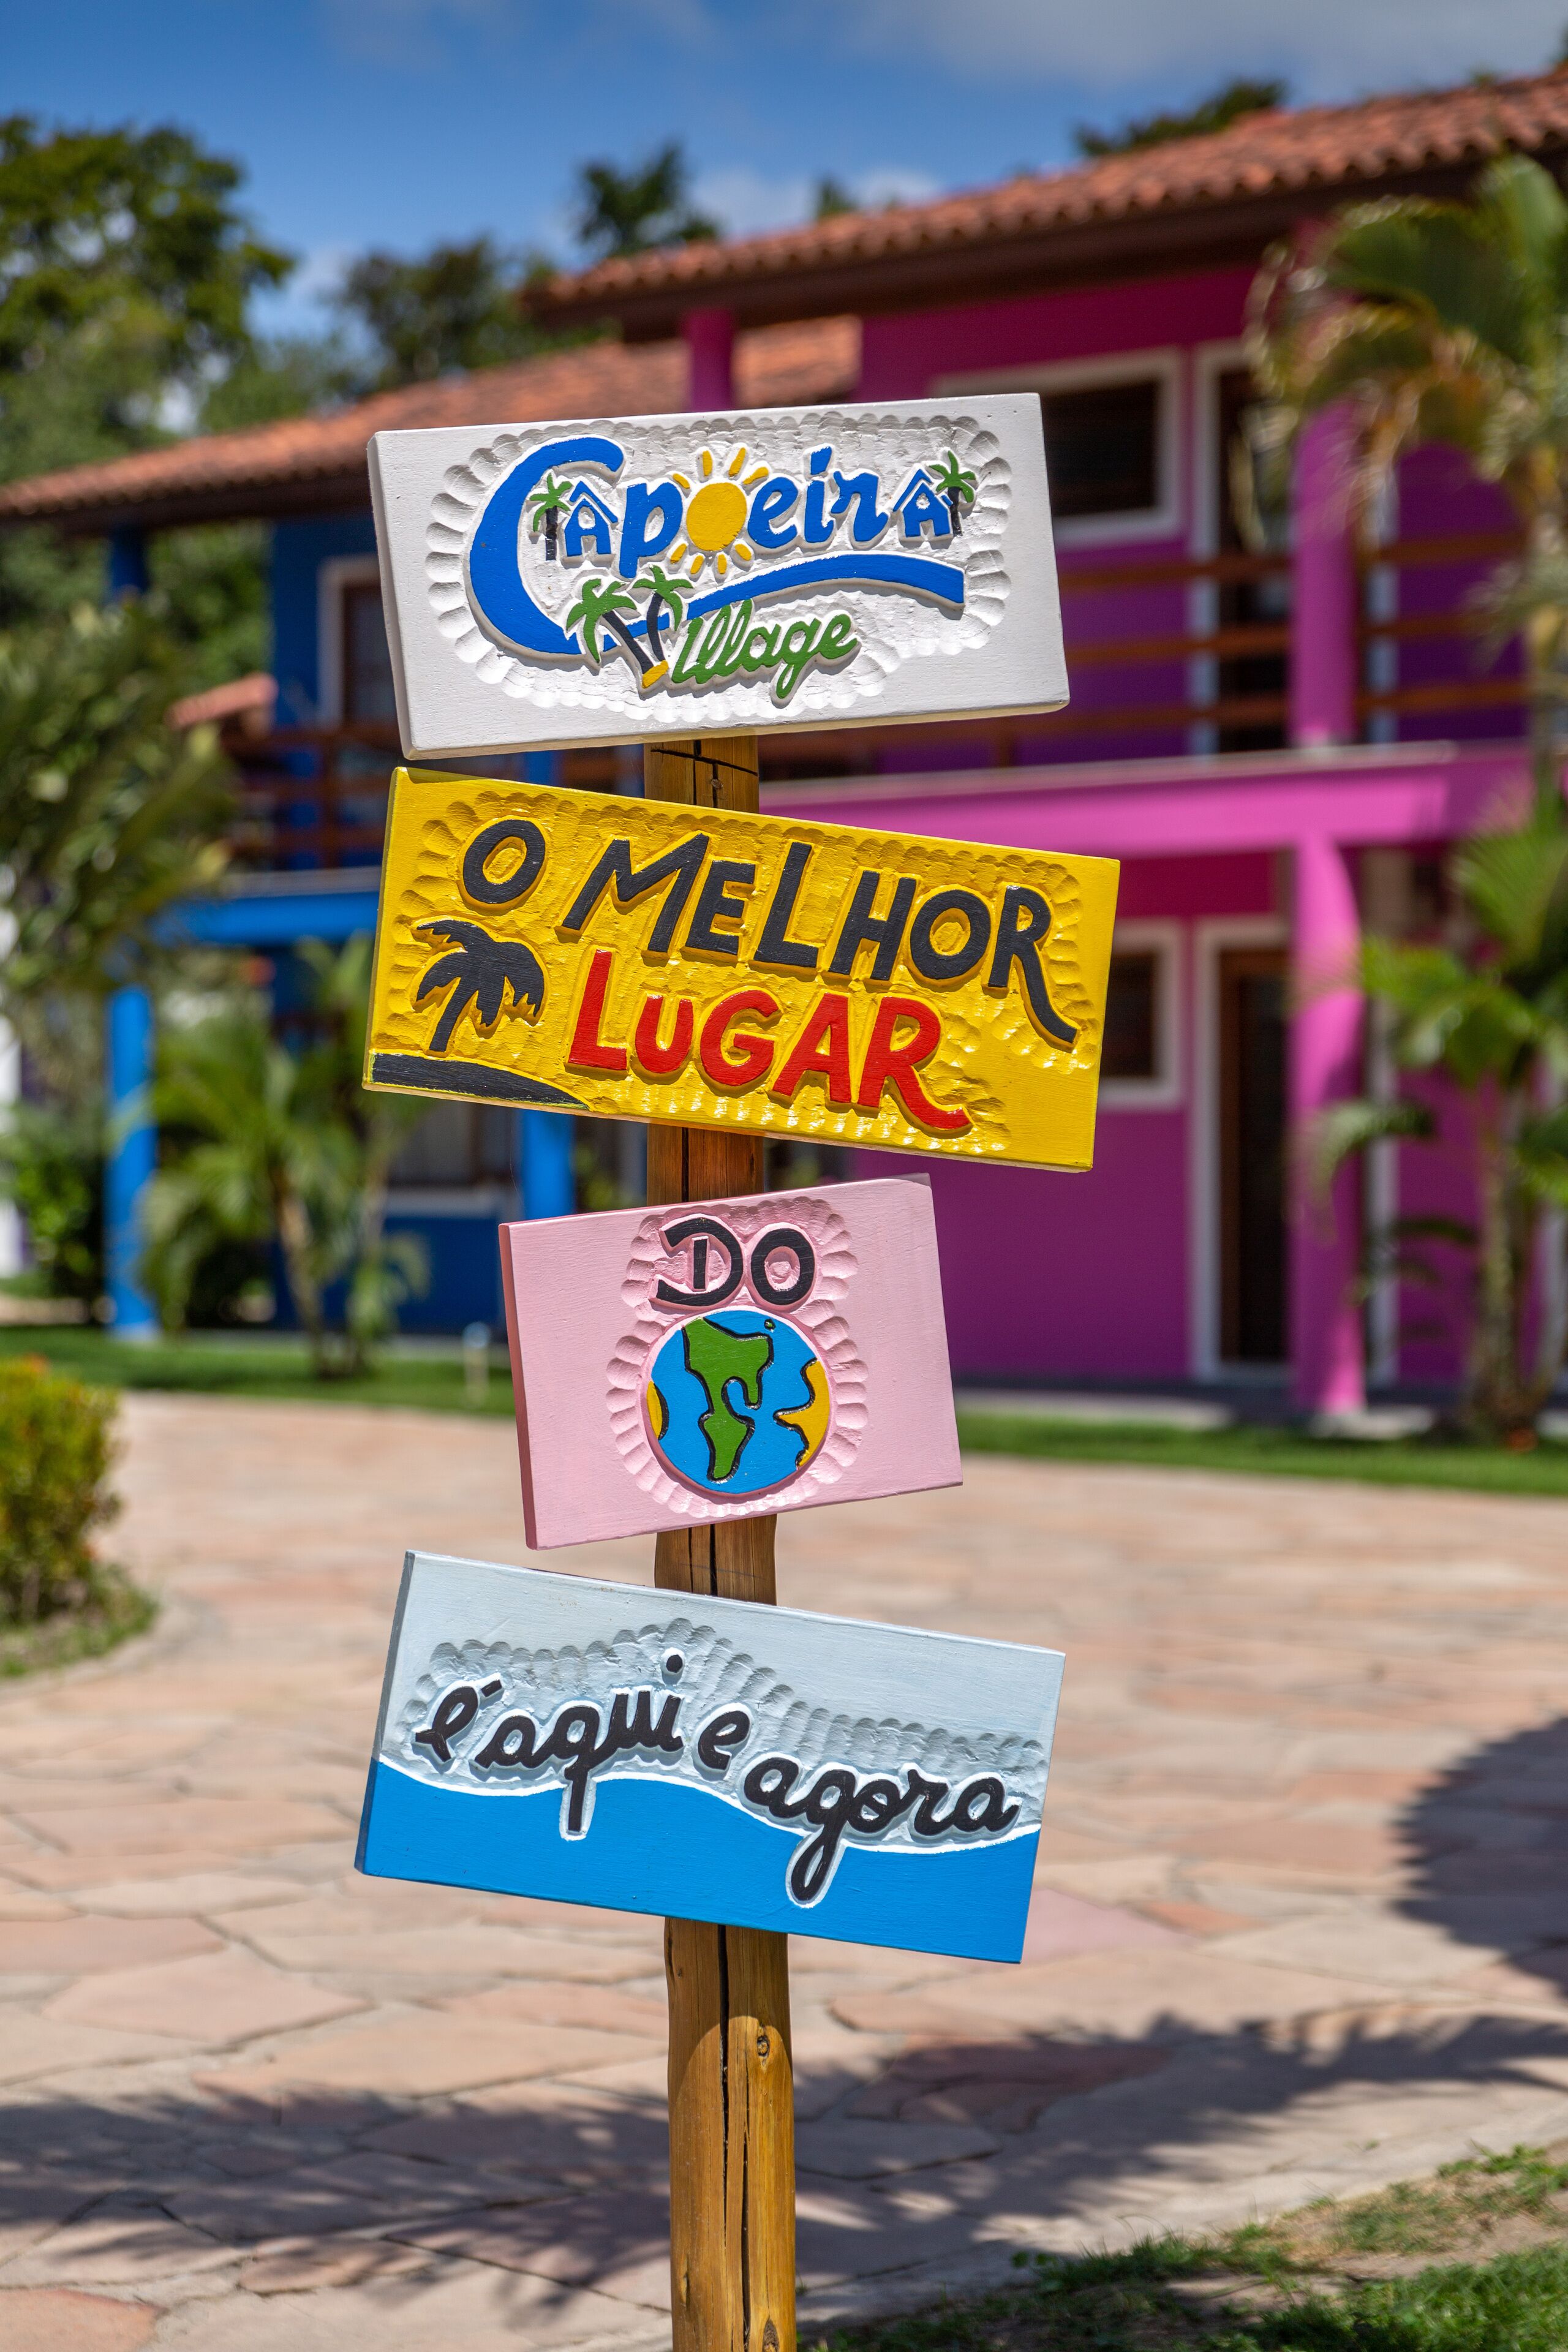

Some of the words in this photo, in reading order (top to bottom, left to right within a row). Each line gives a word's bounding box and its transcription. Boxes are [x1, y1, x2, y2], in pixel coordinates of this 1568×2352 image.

[462, 819, 546, 903] O
[562, 832, 1078, 1044] MELHOR
[568, 949, 970, 1129] LUGAR
[657, 1217, 815, 1306] DO
[475, 1653, 684, 1832] aqui
[698, 1710, 751, 1770] e
[744, 1755, 1018, 1902] agora
